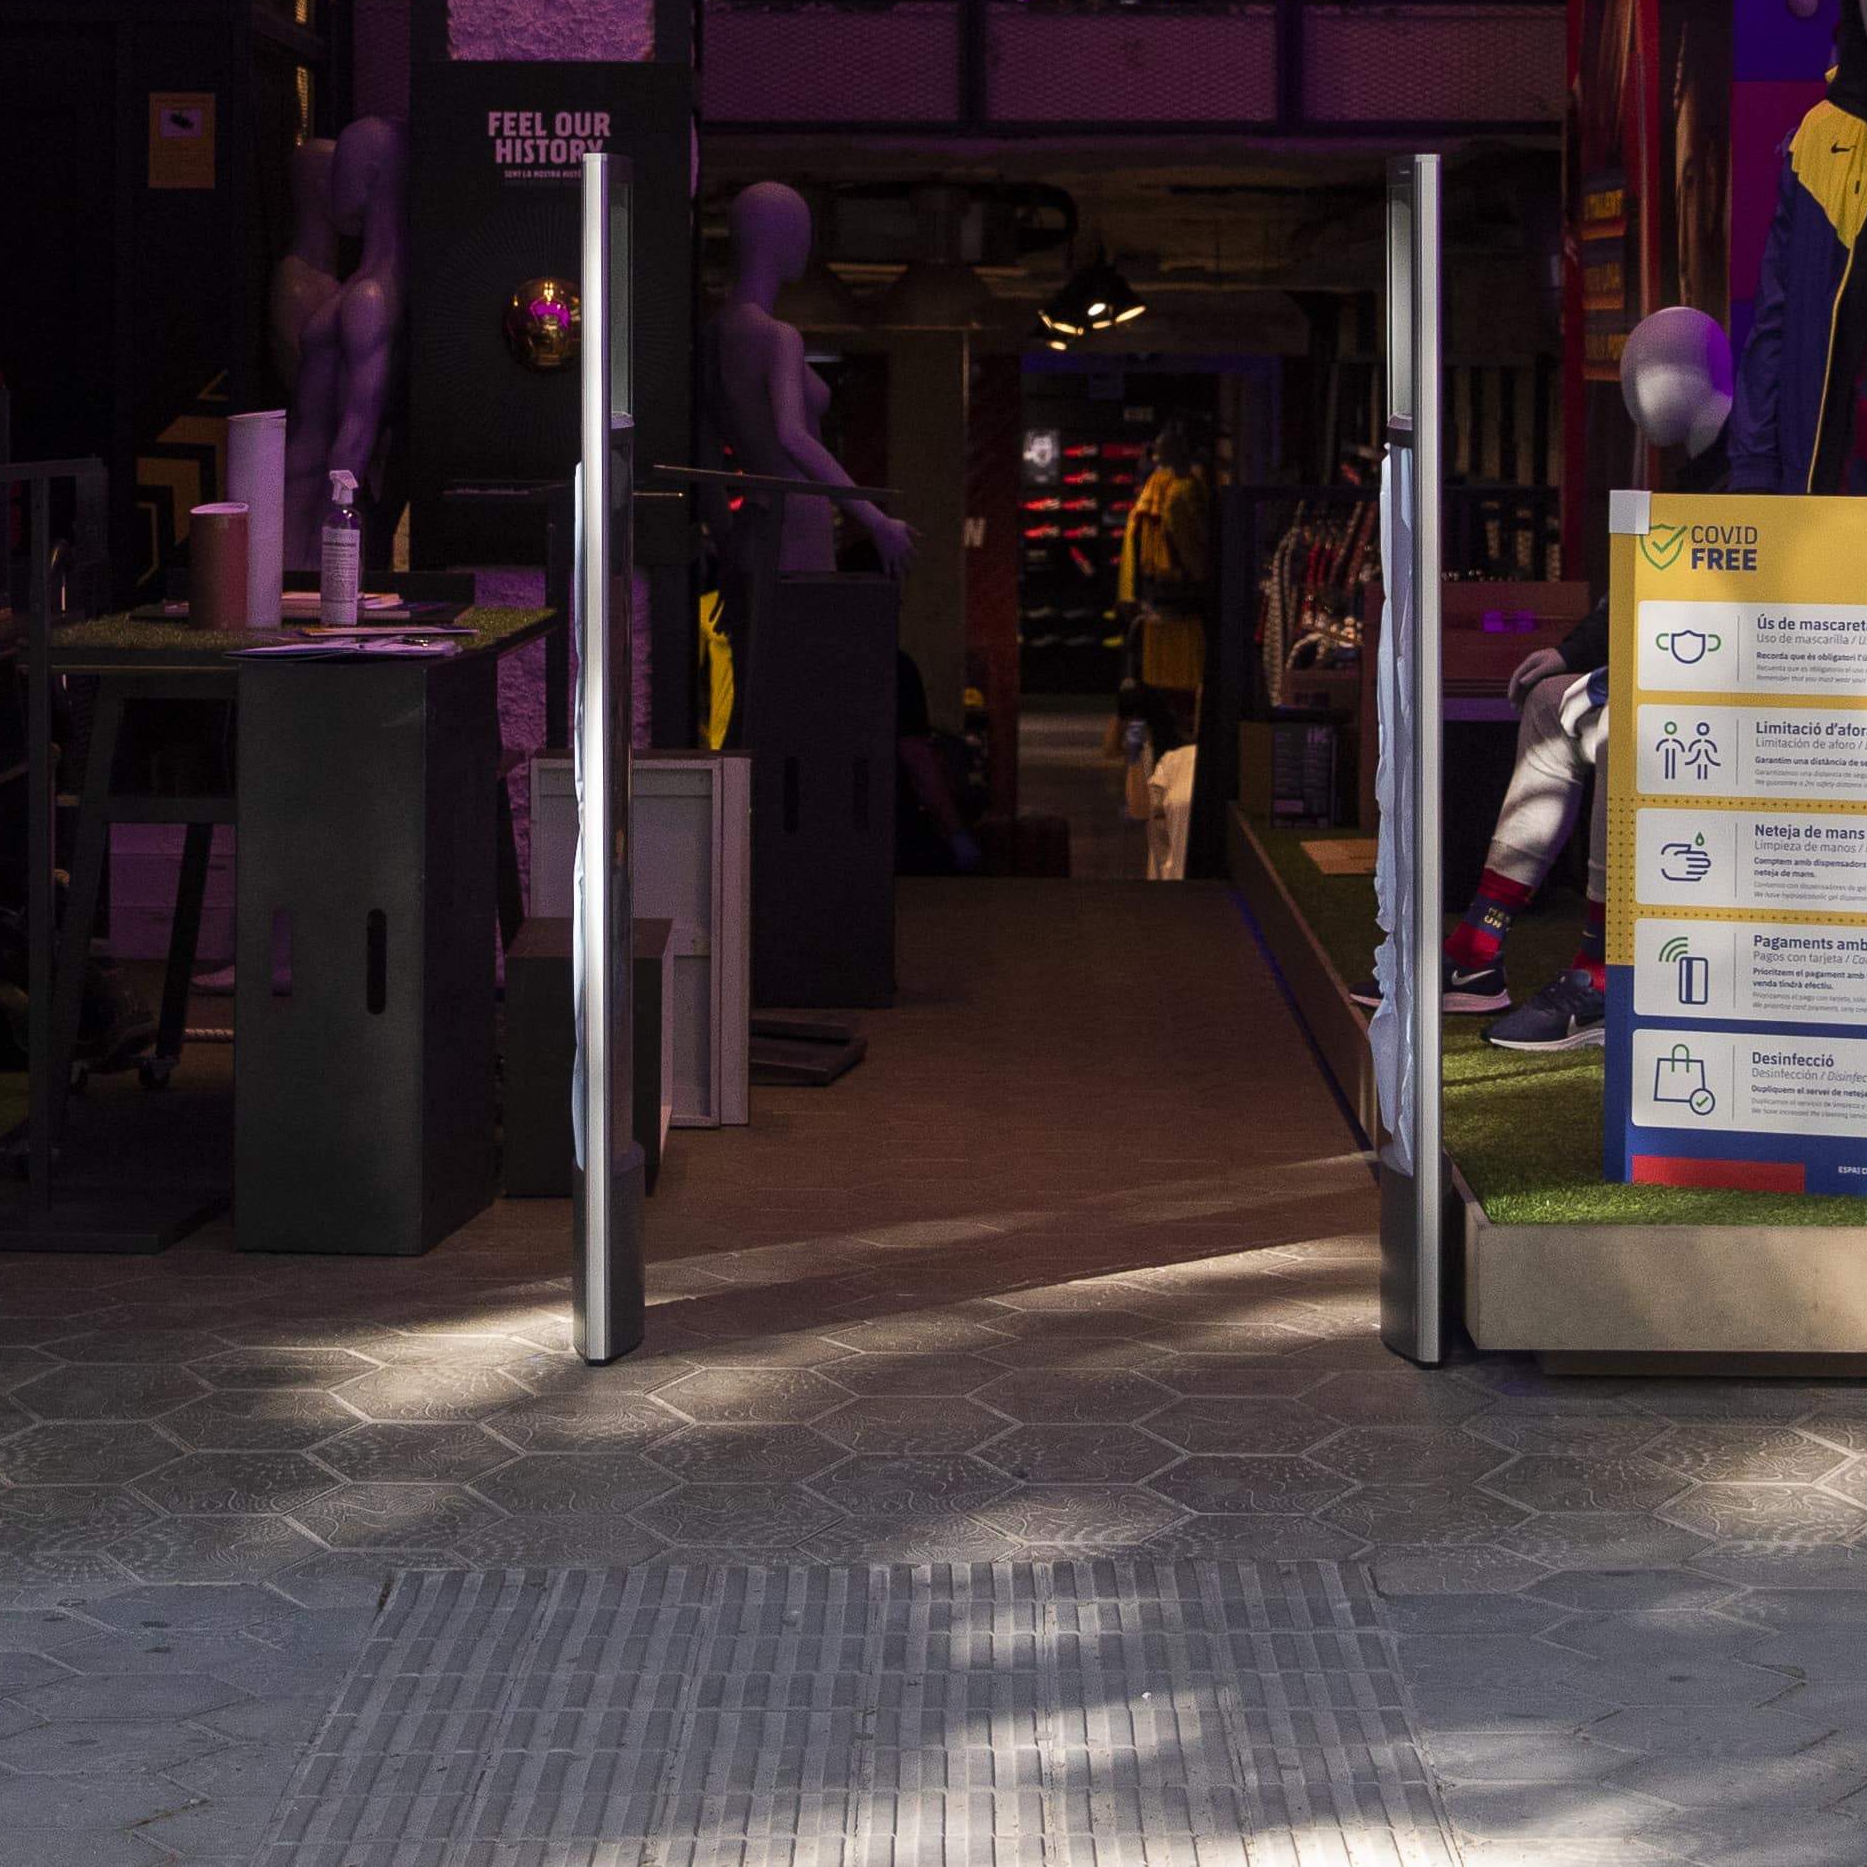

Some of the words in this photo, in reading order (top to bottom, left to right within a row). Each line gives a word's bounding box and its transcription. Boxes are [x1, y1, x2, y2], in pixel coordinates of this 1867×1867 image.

[488, 111, 547, 137] FEEL
[554, 111, 611, 137] OUR
[1691, 525, 1758, 544] COVID
[1692, 548, 1758, 570] FREE
[1757, 613, 1775, 630] Ús
[1778, 617, 1795, 630] de
[1757, 634, 1776, 644] Uso
[1779, 634, 1792, 644] de
[1795, 634, 1849, 645] mascarilla
[1851, 635, 1856, 645] /
[1756, 721, 1821, 735] Limitació
[1756, 738, 1810, 749] Limitación
[1812, 739, 1826, 749] de
[1828, 739, 1856, 750] aforo
[1858, 740, 1863, 750] /
[1755, 824, 1800, 839] Neteja
[1804, 825, 1822, 838] de
[1825, 828, 1865, 840] mans
[1754, 840, 1801, 852] Limpieza
[1804, 841, 1817, 852] de
[1820, 843, 1856, 853] manos
[1858, 843, 1863, 853] /
[1754, 935, 1834, 951] Pagaments
[1837, 937, 1867, 951] amb
[1753, 951, 1785, 963] Pagos
[1787, 953, 1806, 962] con
[1809, 953, 1843, 965] tarjeta
[1845, 955, 1850, 964] /
[1752, 1051, 1834, 1067] Desinfecció
[1751, 1067, 1818, 1080] Desinfección
[1820, 1071, 1825, 1081] /
